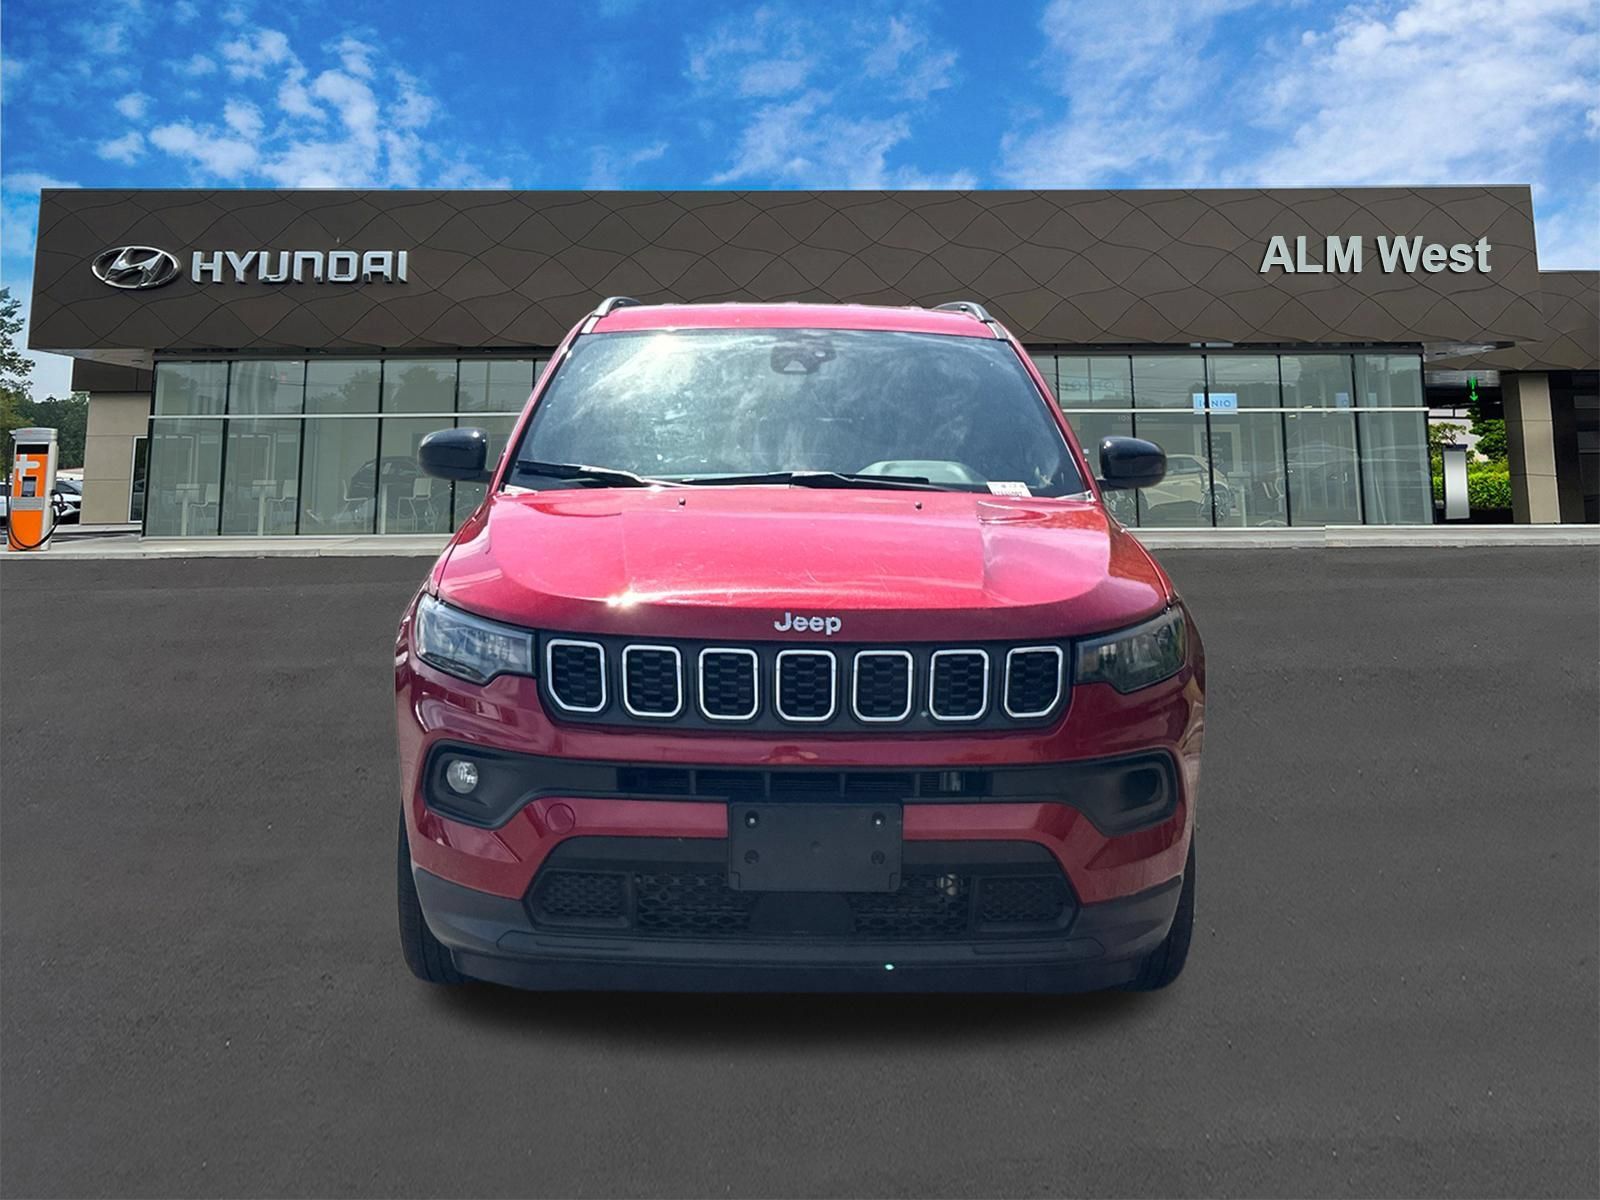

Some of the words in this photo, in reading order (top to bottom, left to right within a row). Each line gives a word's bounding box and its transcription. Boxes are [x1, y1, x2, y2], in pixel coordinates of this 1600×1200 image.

[192, 250, 408, 283] HYUNDAI
[1260, 235, 1363, 273] ALM
[1377, 235, 1492, 273] West
[773, 611, 842, 636] Jeep
